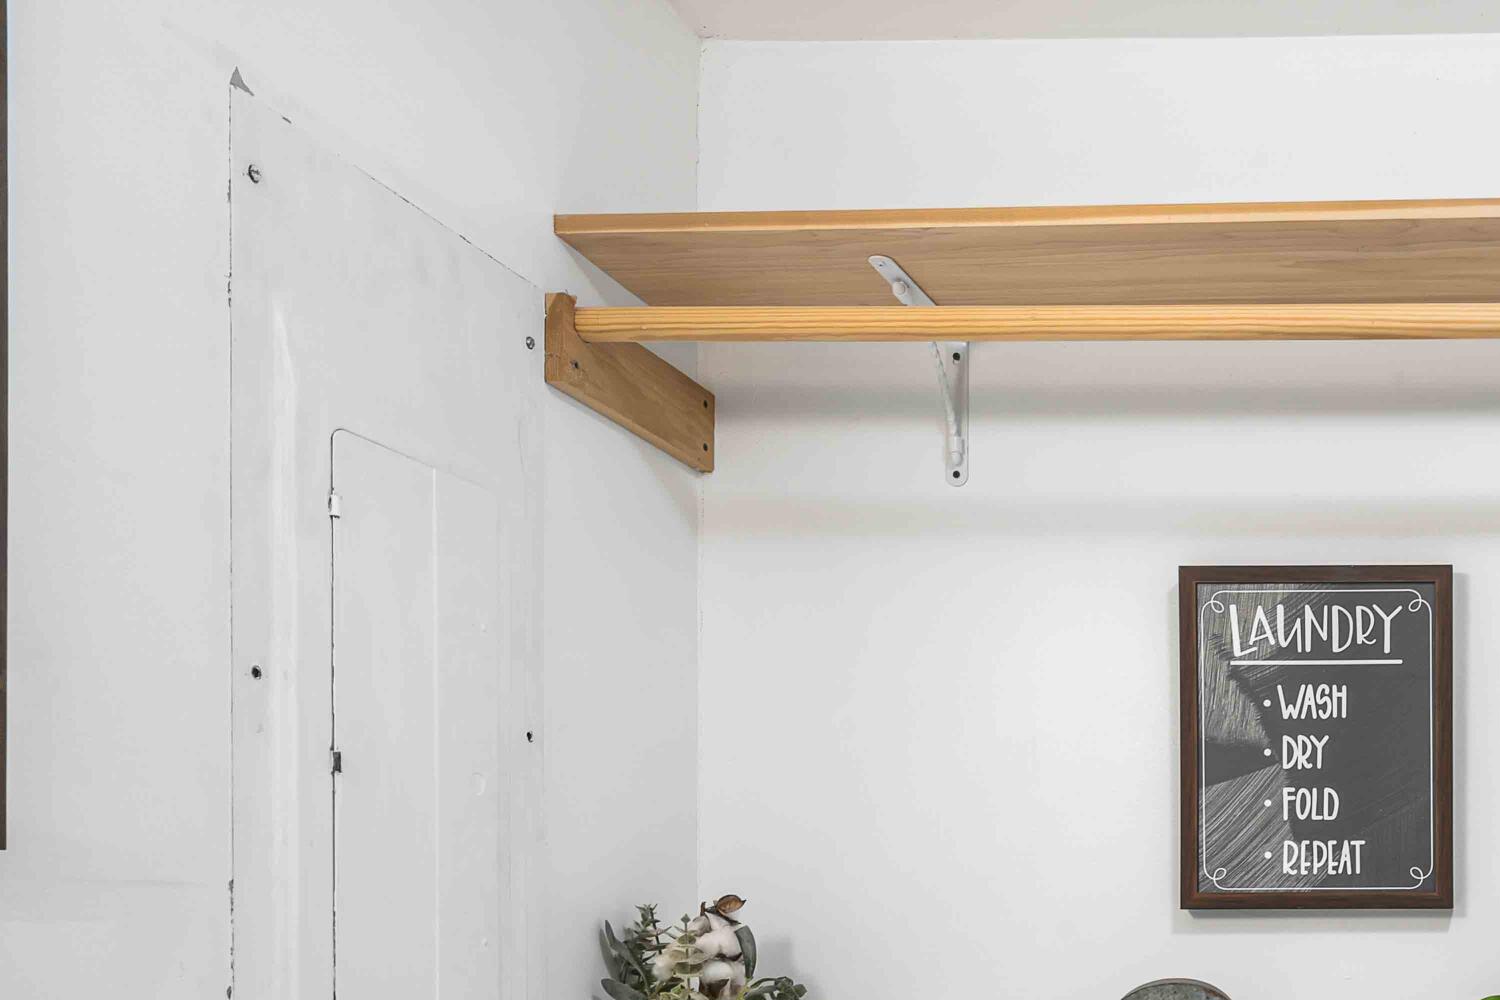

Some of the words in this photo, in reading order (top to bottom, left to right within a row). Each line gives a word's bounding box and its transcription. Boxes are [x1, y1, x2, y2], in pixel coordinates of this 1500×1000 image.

[1229, 604, 1402, 657] LAUNDRY
[1277, 684, 1347, 720] WASH
[1282, 735, 1329, 769] DRY
[1282, 787, 1340, 821] FOLD
[1282, 840, 1366, 875] REPEAT
